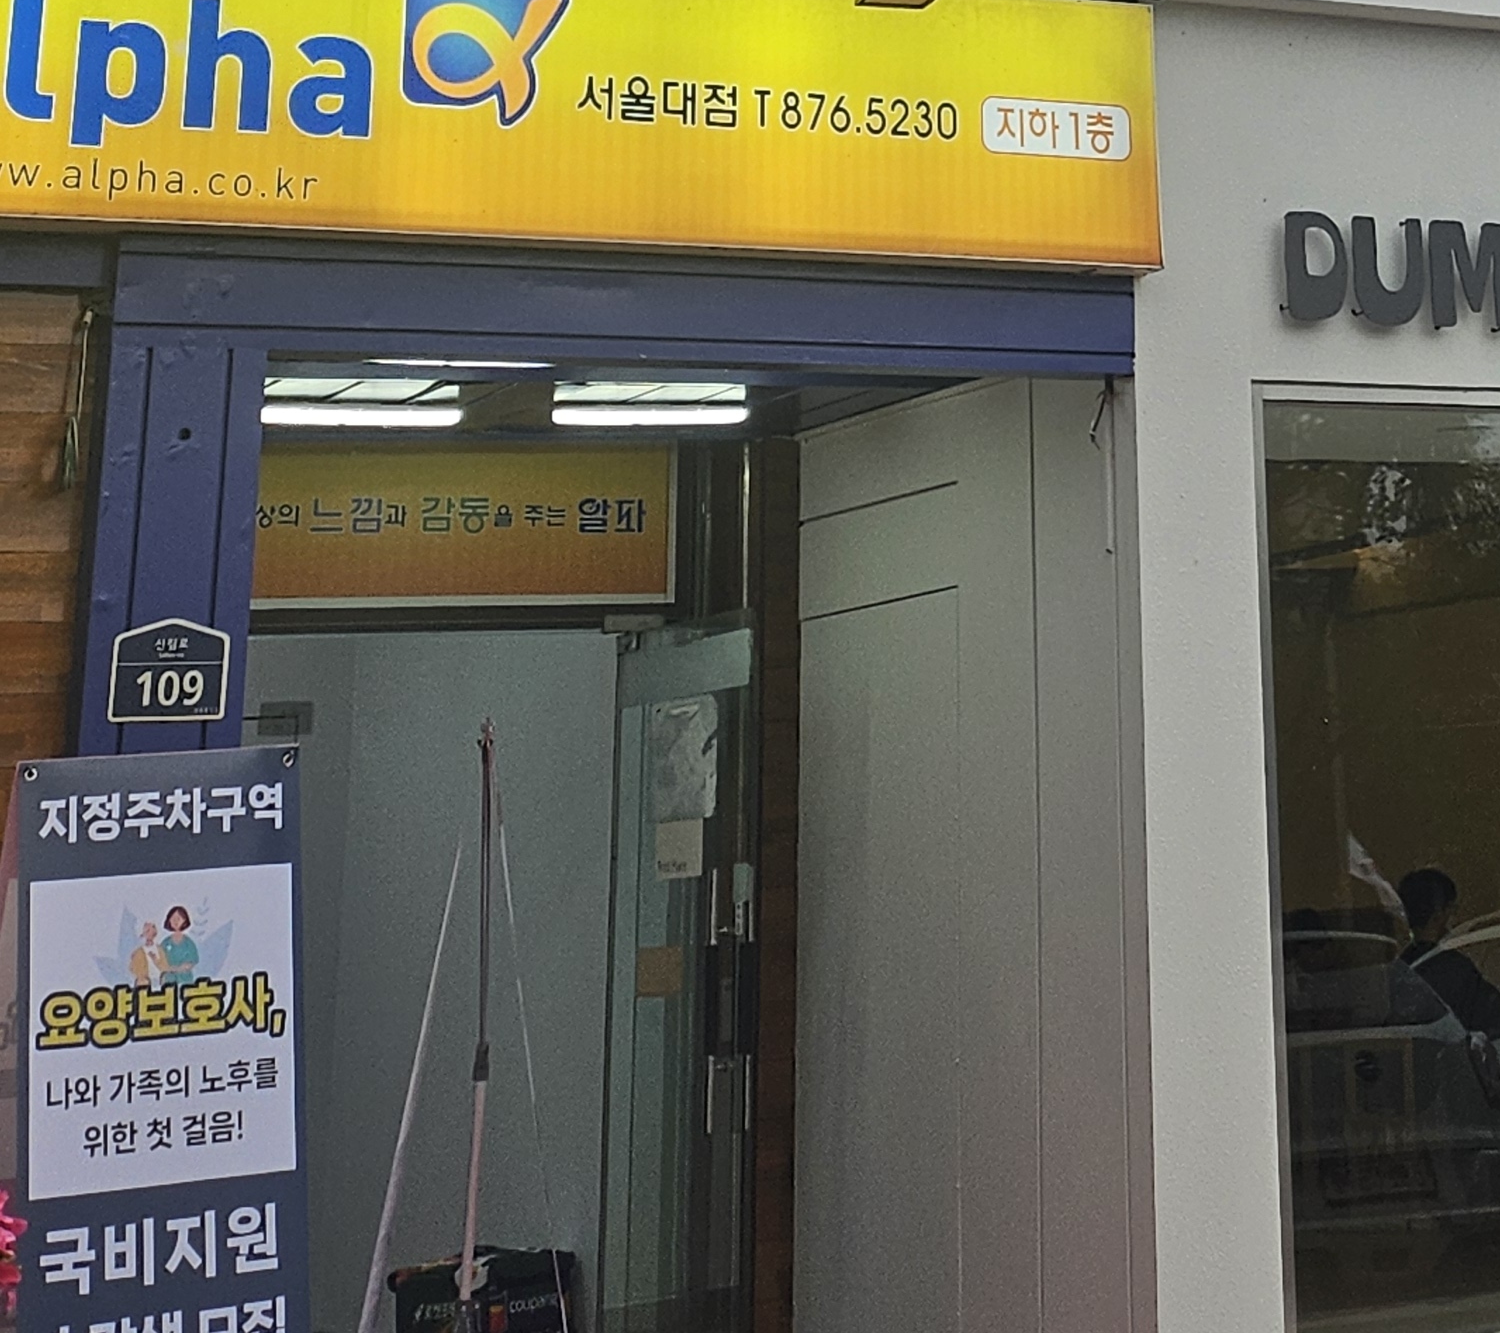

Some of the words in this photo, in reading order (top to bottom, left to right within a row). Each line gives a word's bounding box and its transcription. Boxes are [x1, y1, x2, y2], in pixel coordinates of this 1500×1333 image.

[577, 75, 739, 128] 서울대점
[0, 158, 319, 201] w.alpha.co.kr
[309, 497, 407, 534] 느낌과
[421, 496, 514, 534] 감동을
[523, 504, 566, 528] 주는
[577, 497, 648, 534] 알파
[136, 669, 205, 708] 109
[38, 781, 284, 844] 지정주차구역
[36, 971, 287, 1051] 요양보호사,
[46, 1074, 101, 1111] 나와
[109, 1064, 190, 1105] 가족의
[198, 1056, 279, 1095] 노후를
[83, 1119, 138, 1158] 위한
[146, 1116, 173, 1152] 첫
[182, 1109, 244, 1148] 걸음!
[39, 1201, 279, 1296] 국비지원
